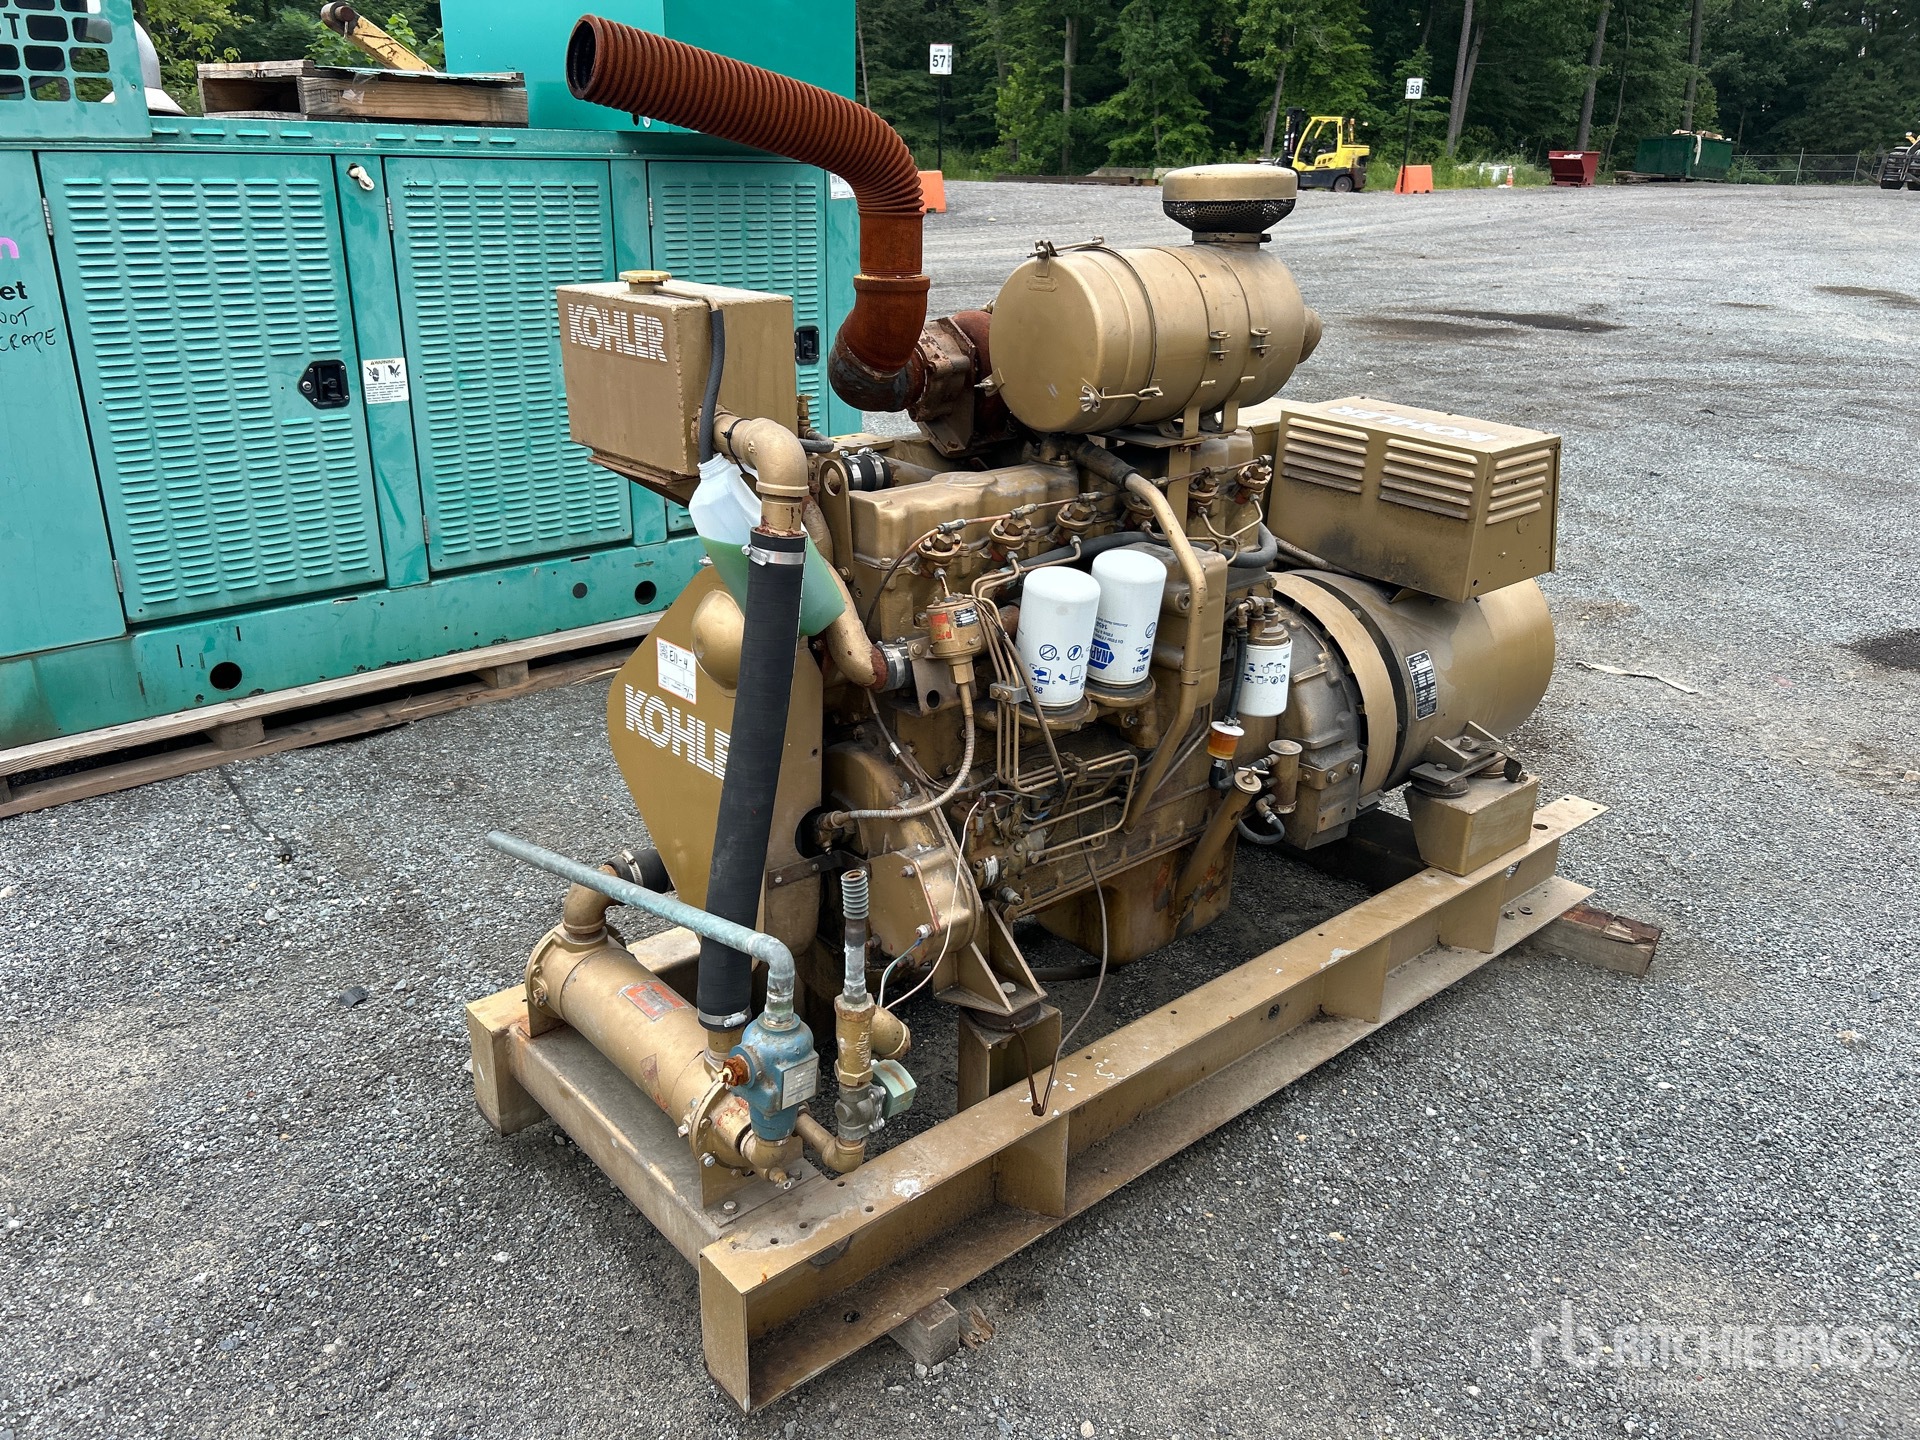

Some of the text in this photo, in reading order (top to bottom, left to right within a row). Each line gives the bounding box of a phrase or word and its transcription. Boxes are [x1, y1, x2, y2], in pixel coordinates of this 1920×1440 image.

[932, 54, 946, 67] 57
[1409, 85, 1420, 94] 58
[567, 303, 668, 362] KOHLER
[1328, 406, 1498, 442] KOHLER
[1090, 646, 1108, 664] NAP
[1032, 685, 1043, 694] 58
[625, 683, 731, 781] KOHLE
